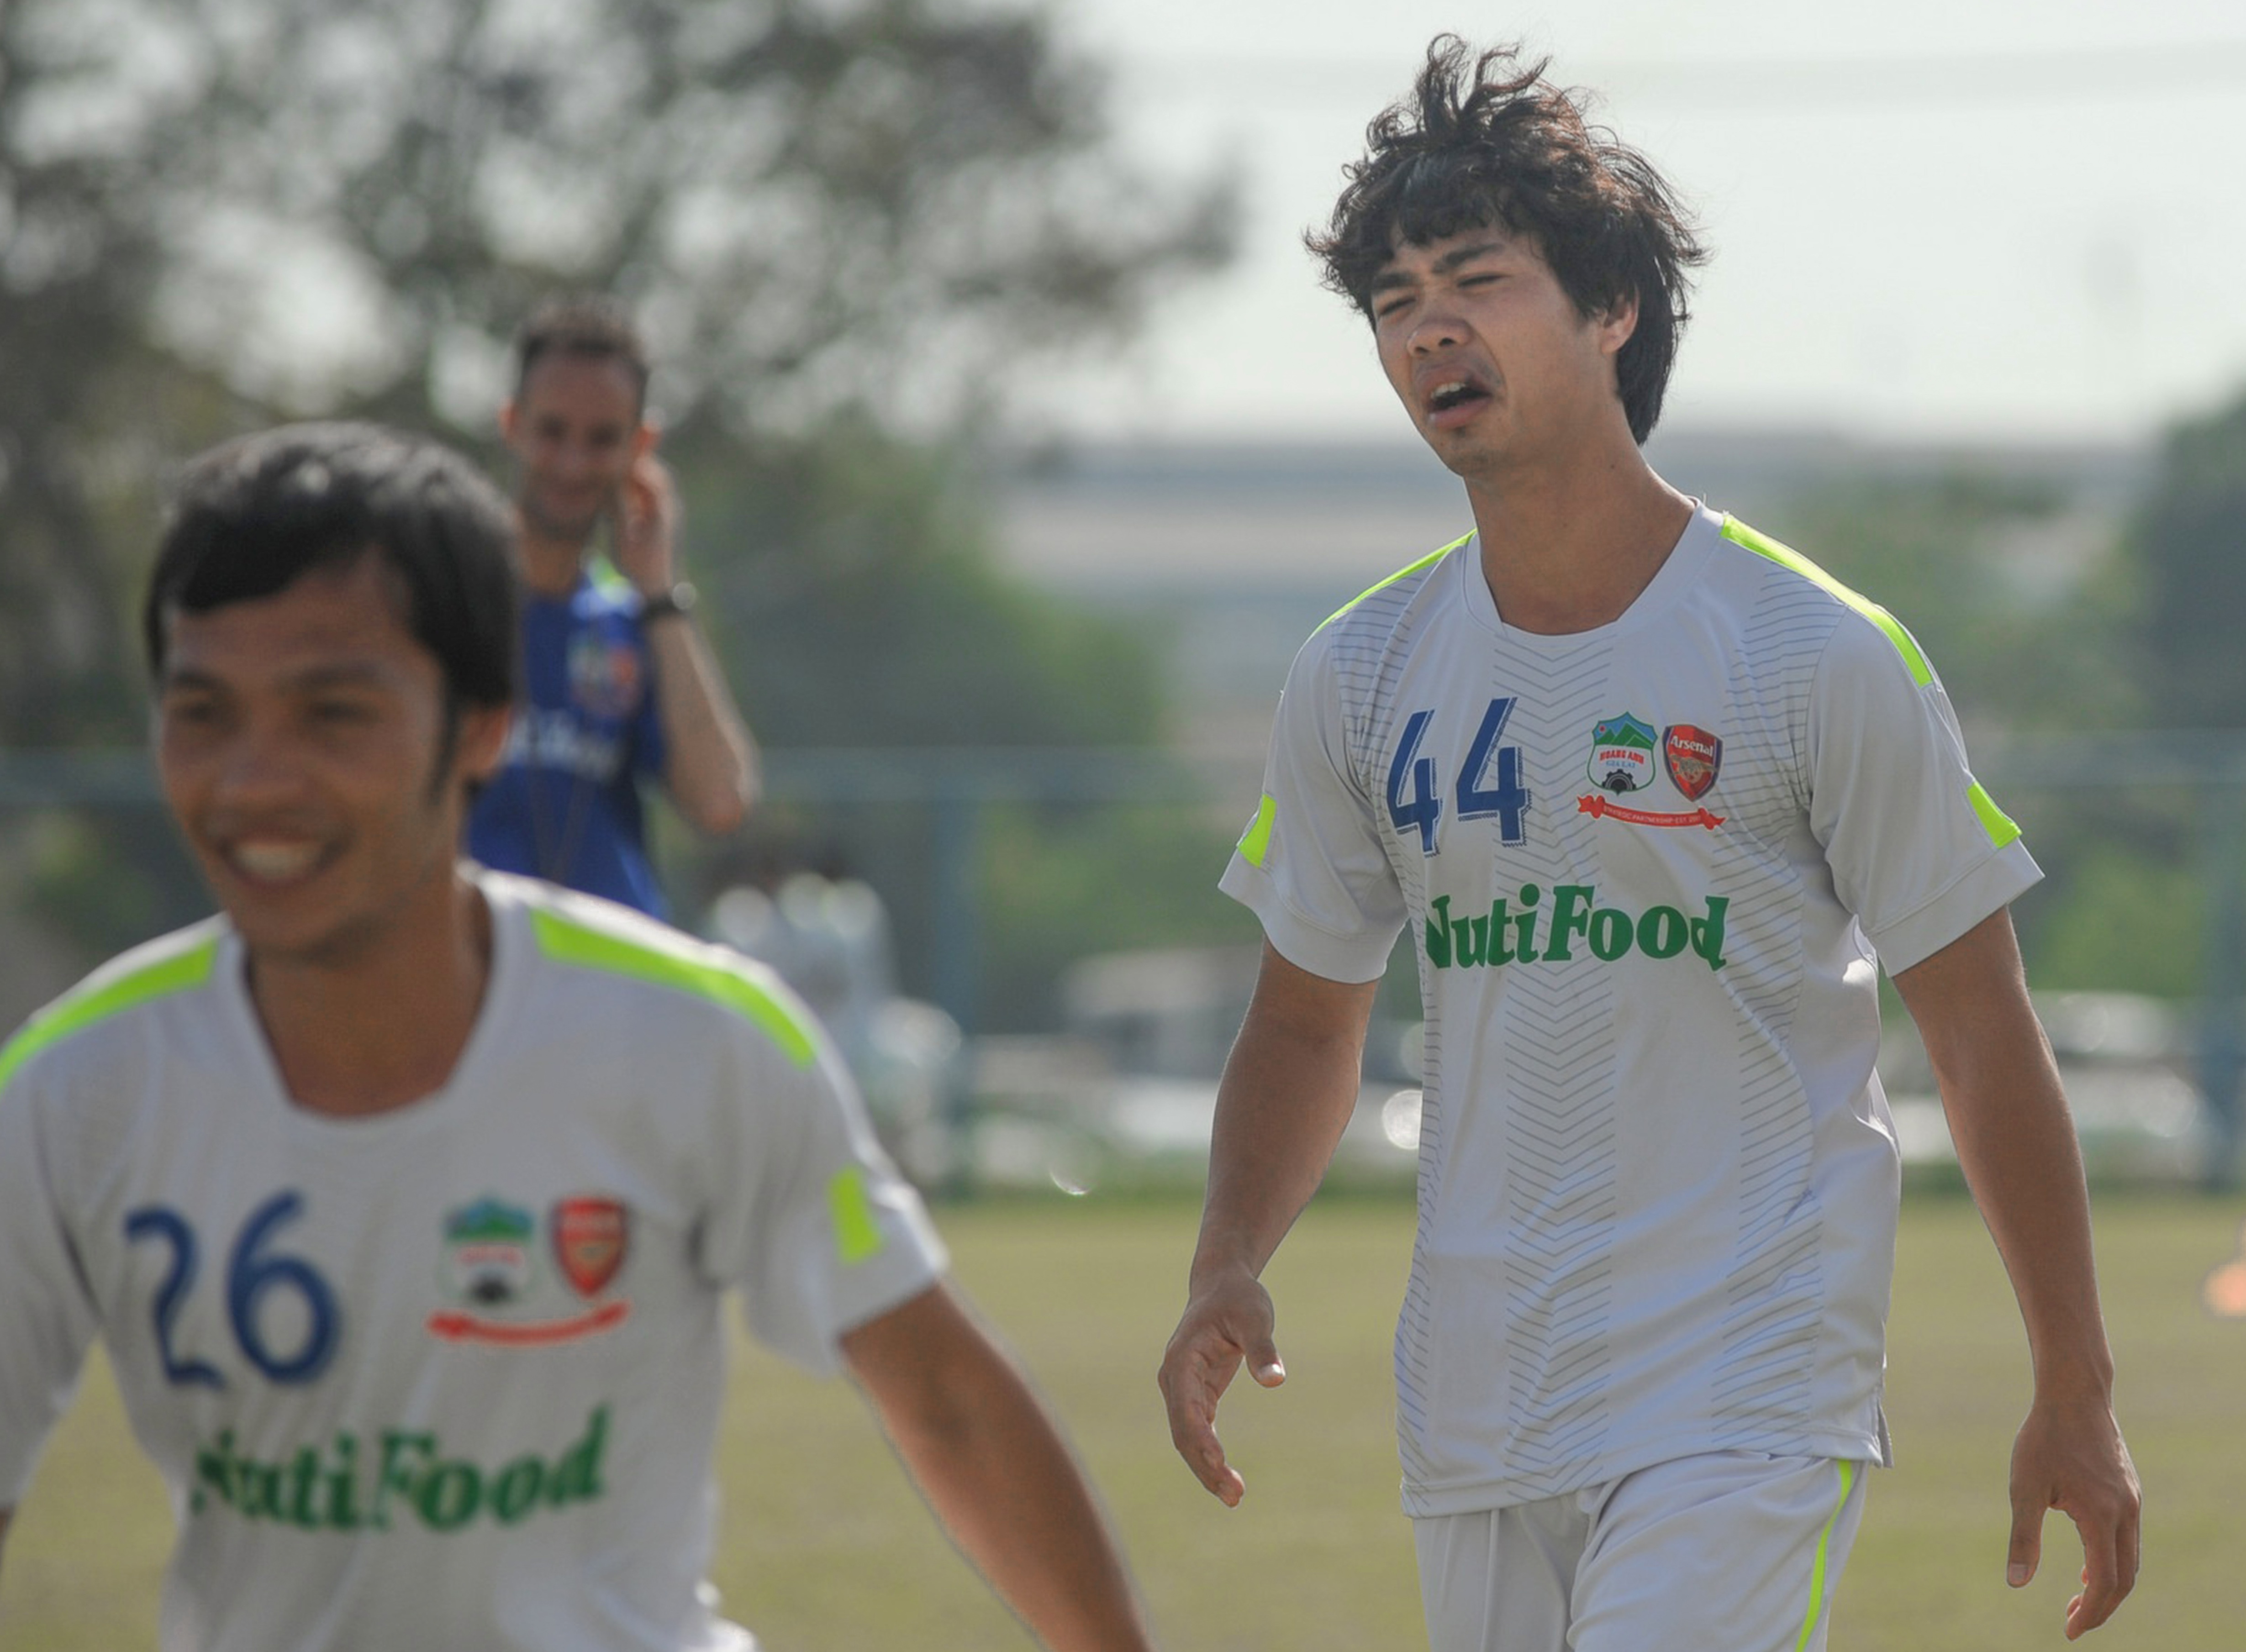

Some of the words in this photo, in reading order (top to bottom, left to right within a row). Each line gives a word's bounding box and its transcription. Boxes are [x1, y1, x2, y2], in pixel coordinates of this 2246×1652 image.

[1387, 697, 1532, 858] 44
[1671, 735, 1713, 758] Arsenal
[1425, 883, 1729, 972] NutiFood
[123, 1189, 341, 1390] 26
